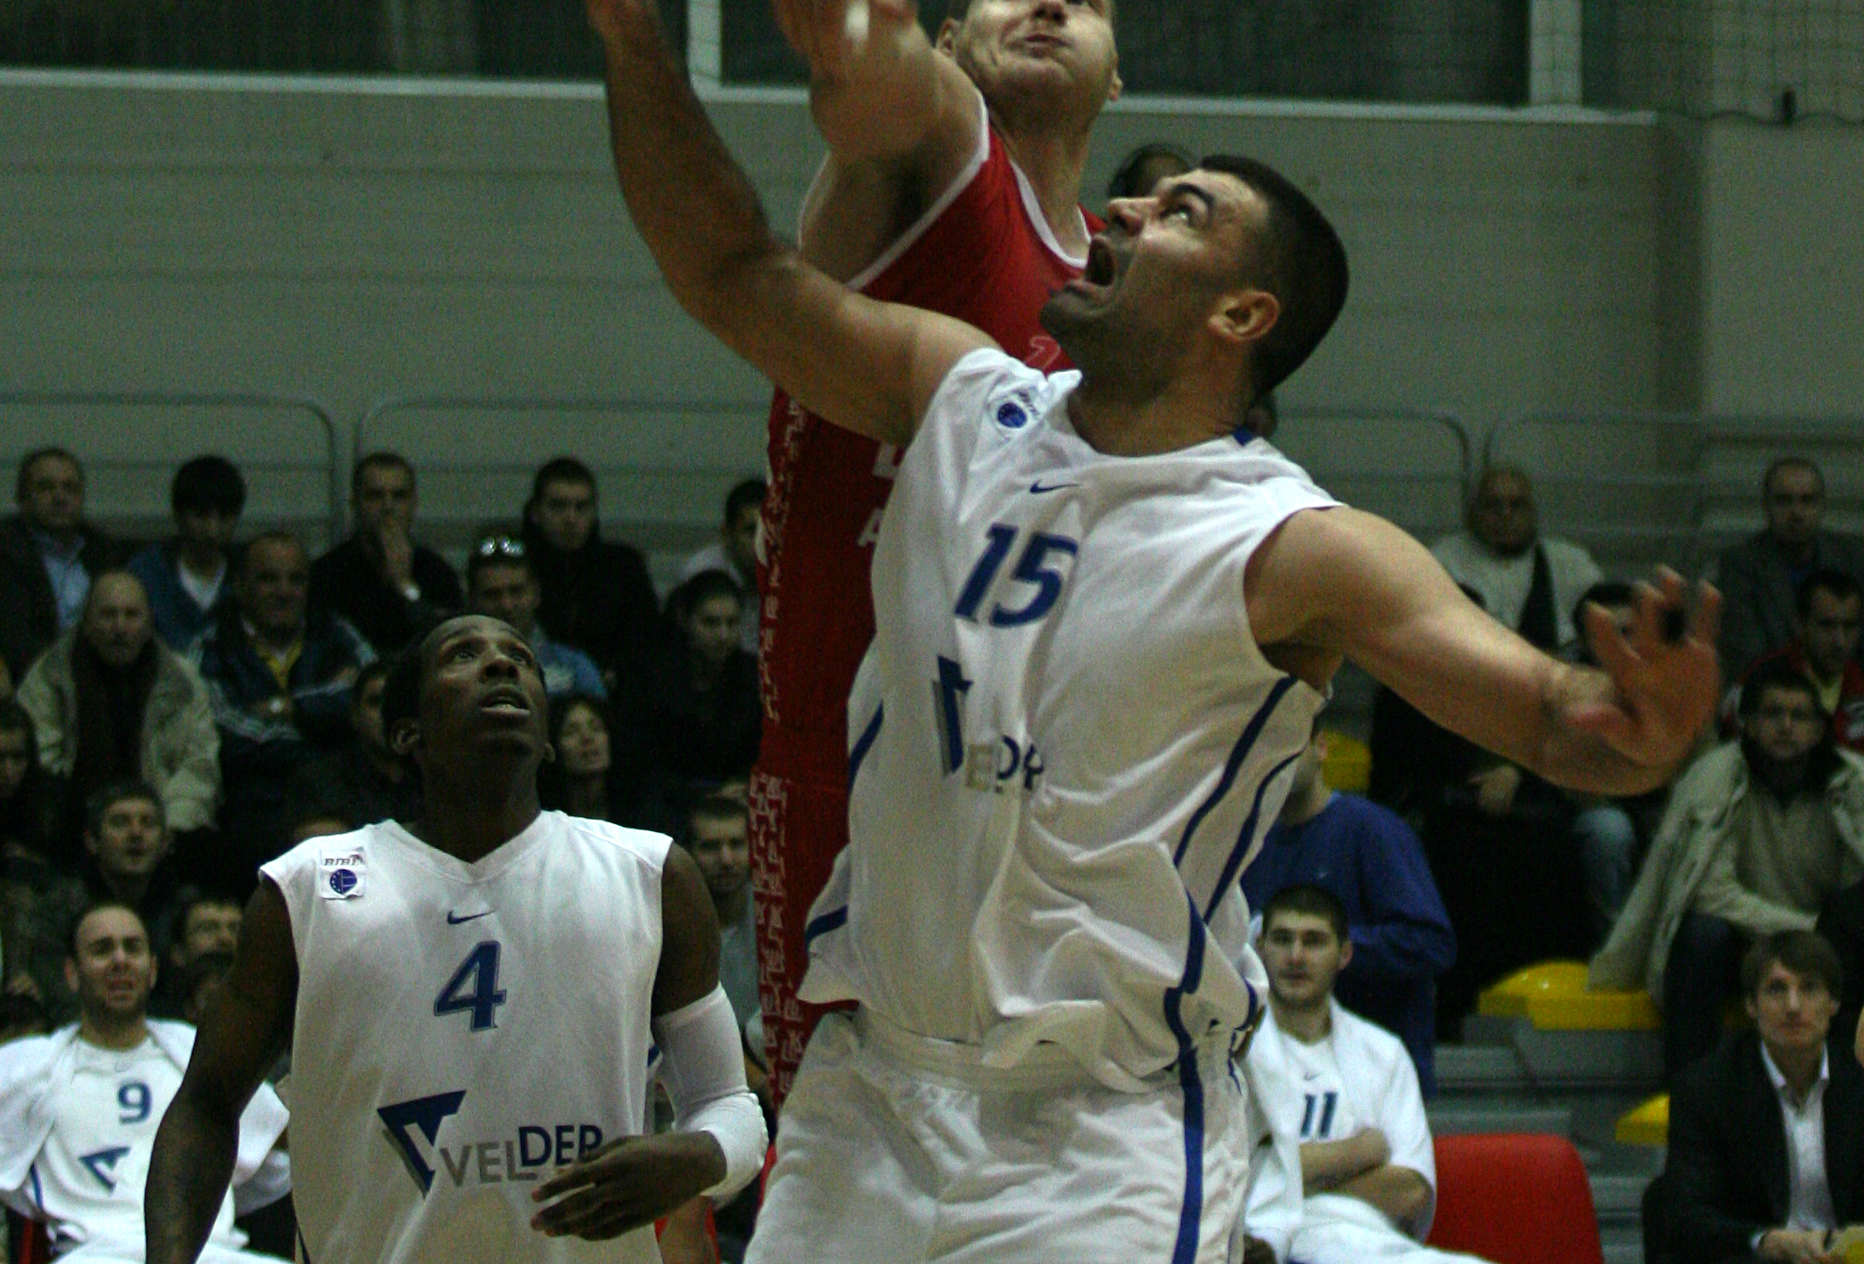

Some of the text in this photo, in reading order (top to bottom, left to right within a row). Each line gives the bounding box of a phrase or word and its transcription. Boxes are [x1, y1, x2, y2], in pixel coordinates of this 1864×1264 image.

[953, 522, 1079, 628] 15
[433, 940, 508, 1033] 4
[116, 1081, 153, 1125] 9
[1300, 1091, 1340, 1139] 11
